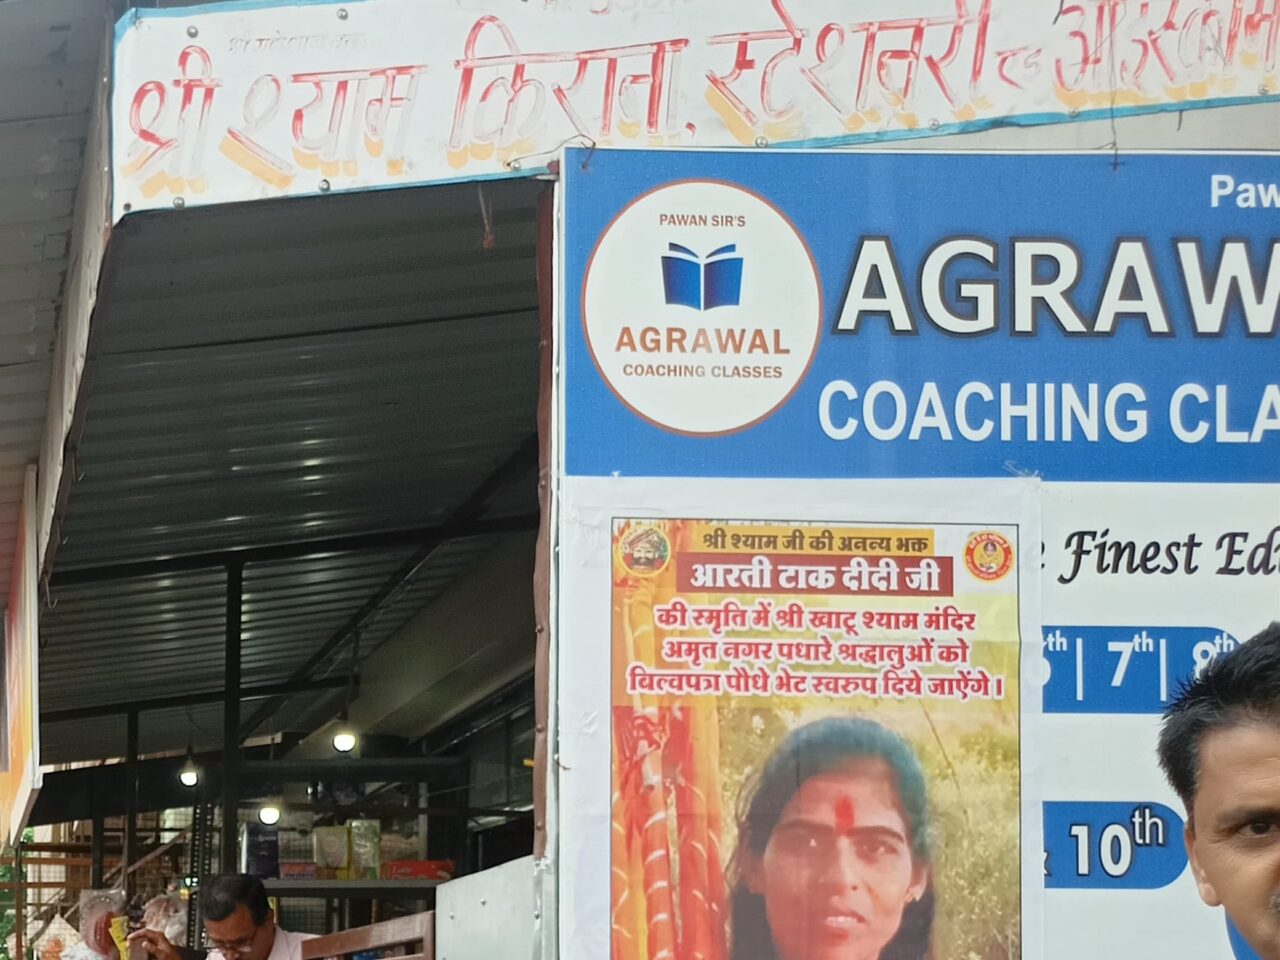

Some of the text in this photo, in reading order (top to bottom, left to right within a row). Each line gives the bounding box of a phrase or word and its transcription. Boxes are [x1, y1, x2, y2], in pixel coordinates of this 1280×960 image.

[123, 45, 222, 197] श्री
[220, 65, 426, 189] श्याम
[659, 213, 746, 228] PAWAN SIR'S
[830, 234, 1280, 340] AGRAW
[615, 326, 791, 355] AGRAWAL
[623, 364, 783, 379] COACHING CLASSES
[818, 379, 1148, 443] COACHING
[703, 528, 928, 552] श्री श्याम जी की अनन्य भक्त
[1057, 528, 1202, 584] Finest
[1215, 525, 1280, 576] Ed
[690, 555, 940, 592] आरती टाक दीदी जी
[656, 602, 976, 636] की स्मृति में श्री खाटू श्याम मंदिर
[665, 635, 969, 669] अमृत नगर पधारे श्रद्धालुओं को
[1107, 631, 1154, 687] 7th
[725, 667, 770, 692] पौधे
[775, 668, 807, 692] भेट
[883, 669, 922, 695] दिये
[1070, 808, 1165, 877] 10th
